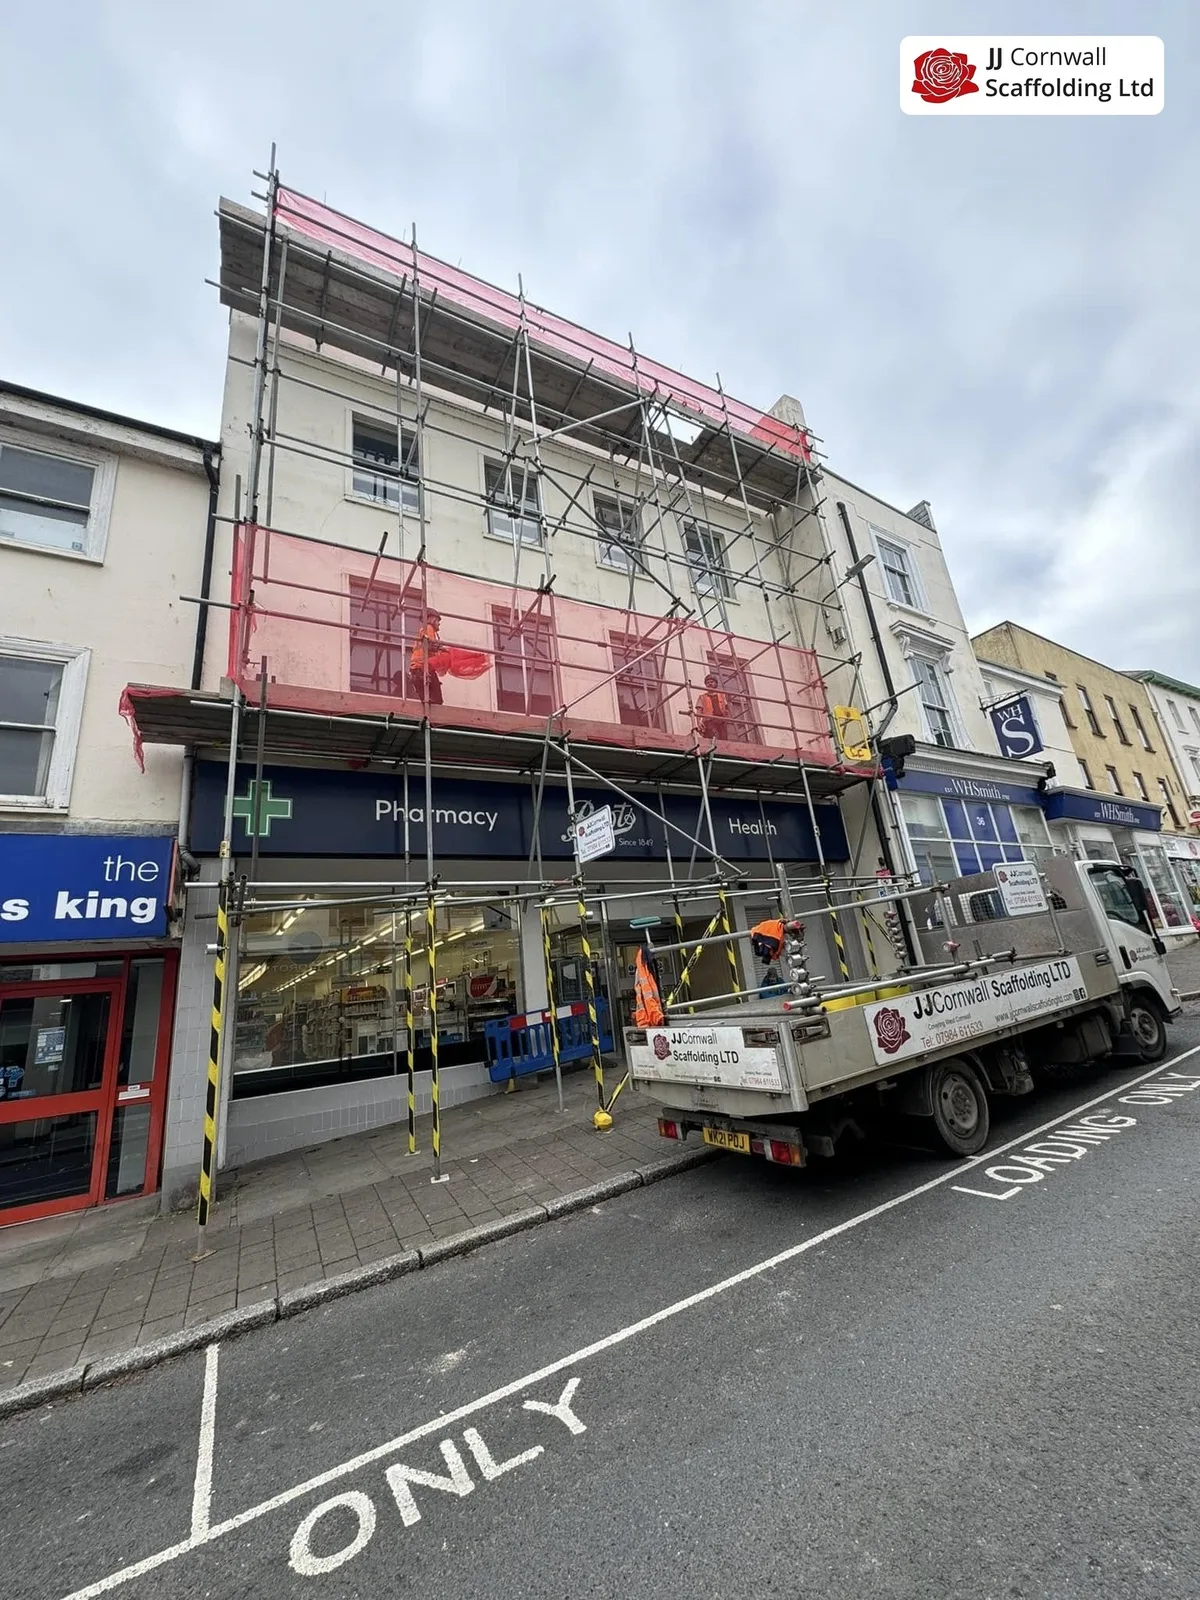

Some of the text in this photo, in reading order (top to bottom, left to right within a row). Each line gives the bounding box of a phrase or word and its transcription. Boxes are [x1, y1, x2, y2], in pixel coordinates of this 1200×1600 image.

[996, 704, 1024, 722] WH
[1001, 716, 1035, 758] S
[951, 778, 1002, 799] WHSmith
[976, 816, 986, 826] 36
[1100, 802, 1134, 823] WHSmith
[618, 837, 636, 846] Since
[638, 838, 654, 846] 1849
[103, 855, 160, 882] the
[0, 891, 157, 924] s king
[990, 970, 1051, 998] Scaffolding
[1049, 960, 1072, 982] LTD
[935, 1026, 958, 1045] 07984
[958, 1019, 984, 1038] 611533
[673, 1050, 740, 1066] Scaffolding LTD
[1118, 1072, 1200, 1105] ONLY
[951, 1115, 1137, 1200] LOADING
[288, 1377, 587, 1576] ONLY
